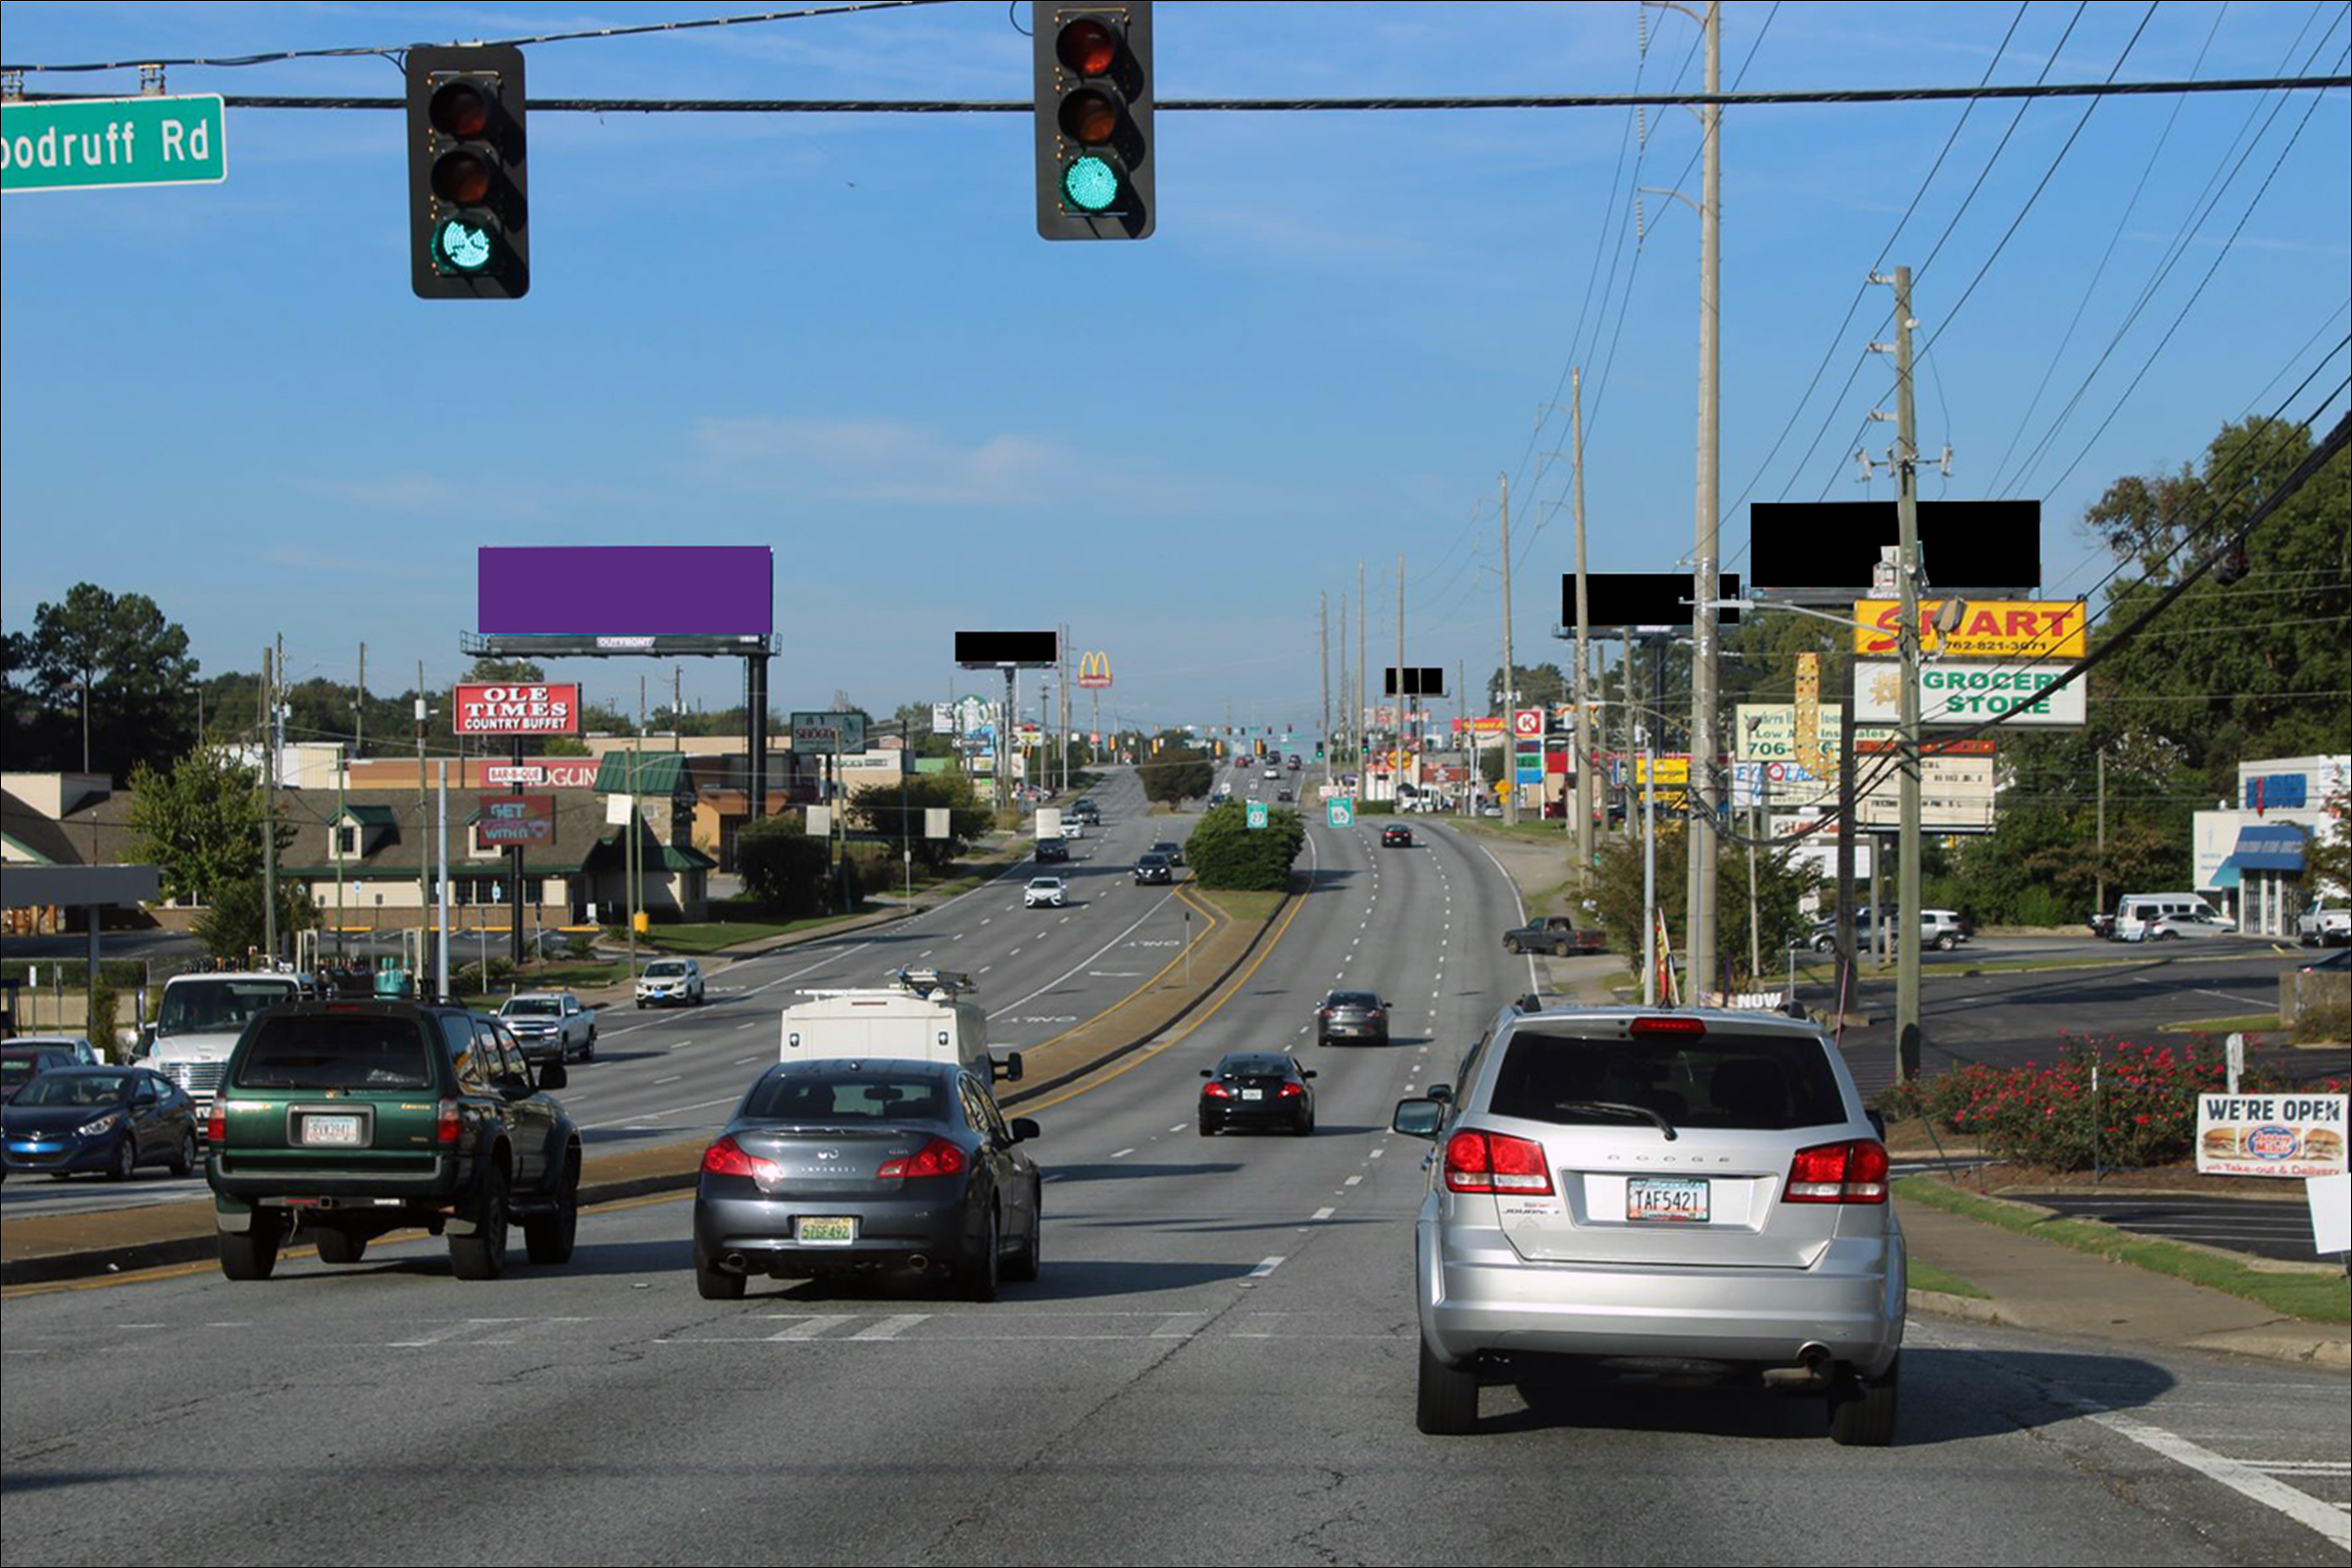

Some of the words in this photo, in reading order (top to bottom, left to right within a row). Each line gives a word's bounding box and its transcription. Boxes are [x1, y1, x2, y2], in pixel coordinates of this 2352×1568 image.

[162, 118, 210, 162] Rd
[483, 687, 550, 702] OLE
[466, 703, 568, 717] TIMES
[1946, 696, 2050, 714] STORE
[465, 717, 521, 730] COUNTRY
[522, 717, 567, 730] BUFFET
[491, 768, 540, 780] BAR-B-QUE
[490, 803, 526, 818] GET
[1737, 993, 1783, 1008] NOW
[2206, 1099, 2275, 1121] WE'RE
[2282, 1100, 2341, 1122] OPEN
[1607, 1154, 1731, 1163] DODGE
[1636, 1190, 1698, 1211] TAF5421
